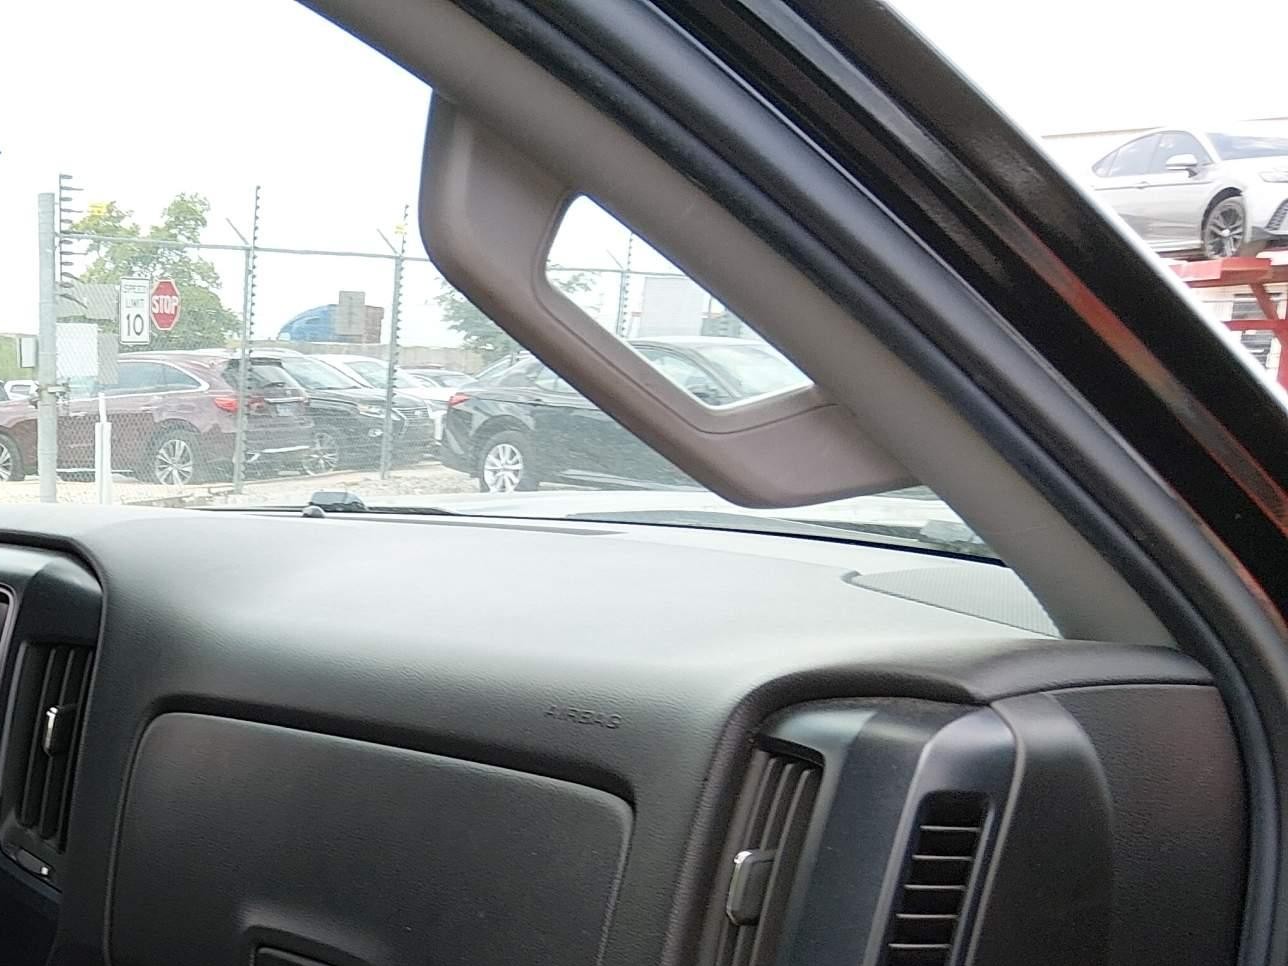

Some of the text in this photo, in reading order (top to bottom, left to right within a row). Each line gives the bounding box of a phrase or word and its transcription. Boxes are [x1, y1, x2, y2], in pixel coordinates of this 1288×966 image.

[152, 295, 178, 315] STOP
[126, 313, 144, 336] 10
[544, 704, 622, 730] AIRBAG
